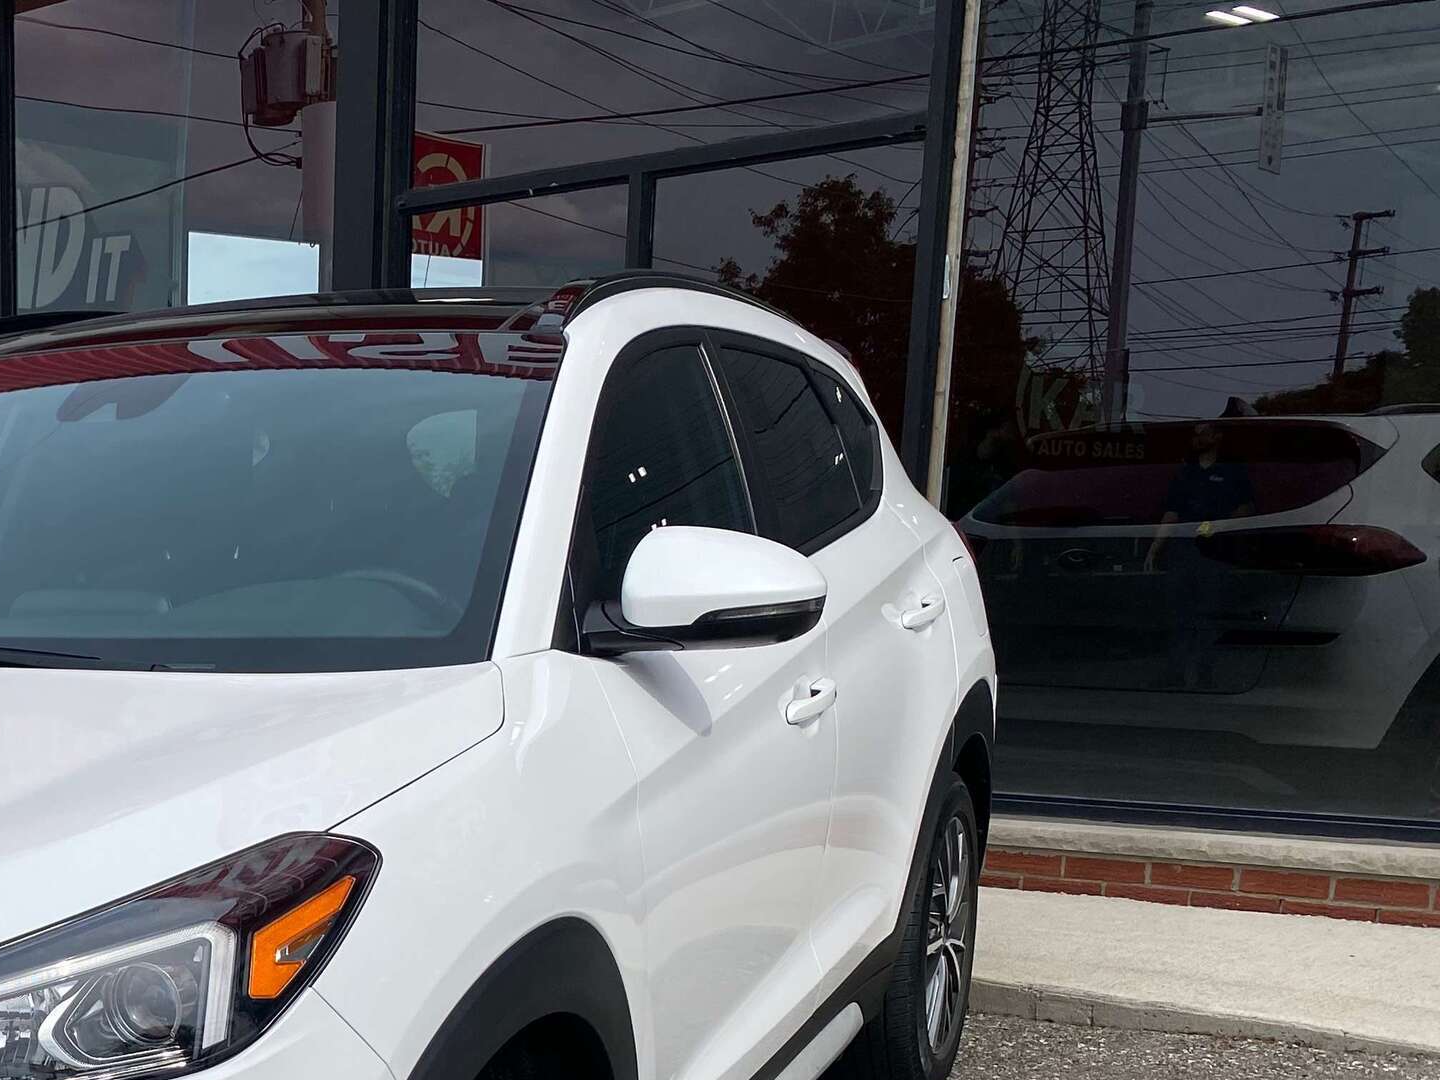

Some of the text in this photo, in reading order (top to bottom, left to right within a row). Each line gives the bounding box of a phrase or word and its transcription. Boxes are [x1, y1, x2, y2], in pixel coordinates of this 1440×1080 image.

[85, 234, 132, 304] IT
[1038, 439, 1145, 460] AUTO SALES
